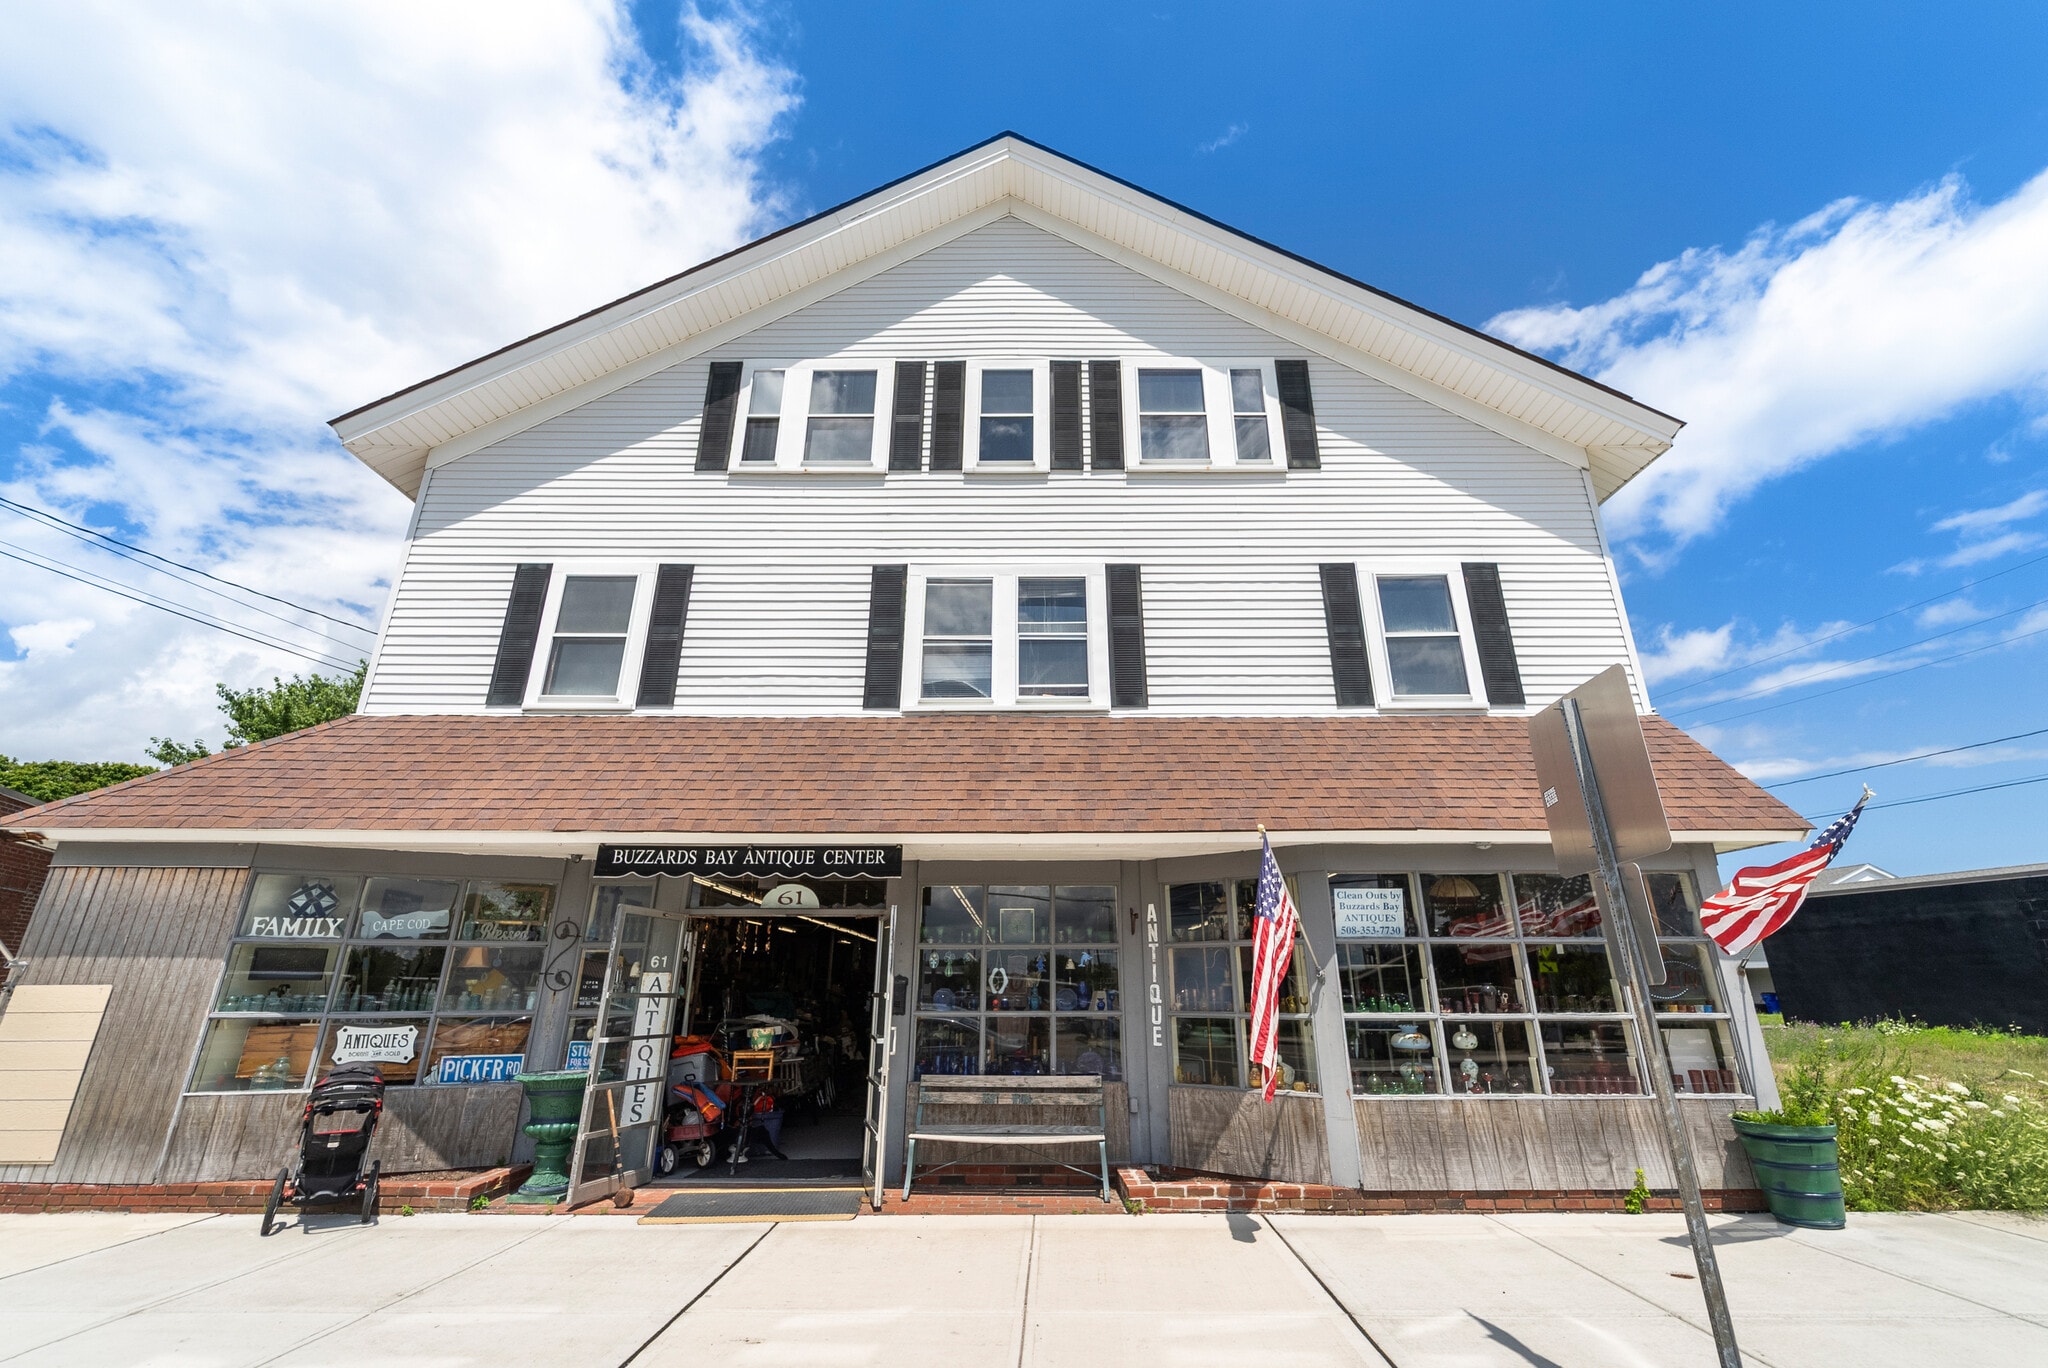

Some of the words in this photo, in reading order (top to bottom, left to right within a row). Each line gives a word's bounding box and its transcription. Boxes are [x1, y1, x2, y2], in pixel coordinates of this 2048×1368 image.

[612, 849, 697, 865] BUZZARDS
[704, 849, 738, 865] BAY
[743, 849, 815, 868] ANTIQUE
[823, 849, 886, 865] CENTER
[777, 890, 803, 906] 61
[1336, 891, 1363, 899] Clean
[1365, 891, 1388, 899] Outs
[1390, 891, 1401, 902] by
[1339, 902, 1380, 910] Buzzards
[1383, 902, 1400, 913] Bay
[246, 916, 344, 938] FAMILY
[373, 919, 404, 931] CAPE
[407, 918, 431, 930] COD
[1344, 914, 1397, 924] ANTIQUES
[480, 921, 531, 940] Blessed
[1341, 926, 1401, 935] 508-353-7730
[650, 955, 668, 968] 61
[1146, 903, 1163, 1047] ANTIQUE
[343, 1033, 409, 1049] ANTIQUES
[629, 976, 662, 1122] ANTIQUES
[571, 1045, 591, 1057] STU
[443, 1059, 504, 1081] PICKER
[506, 1061, 521, 1076] RD
